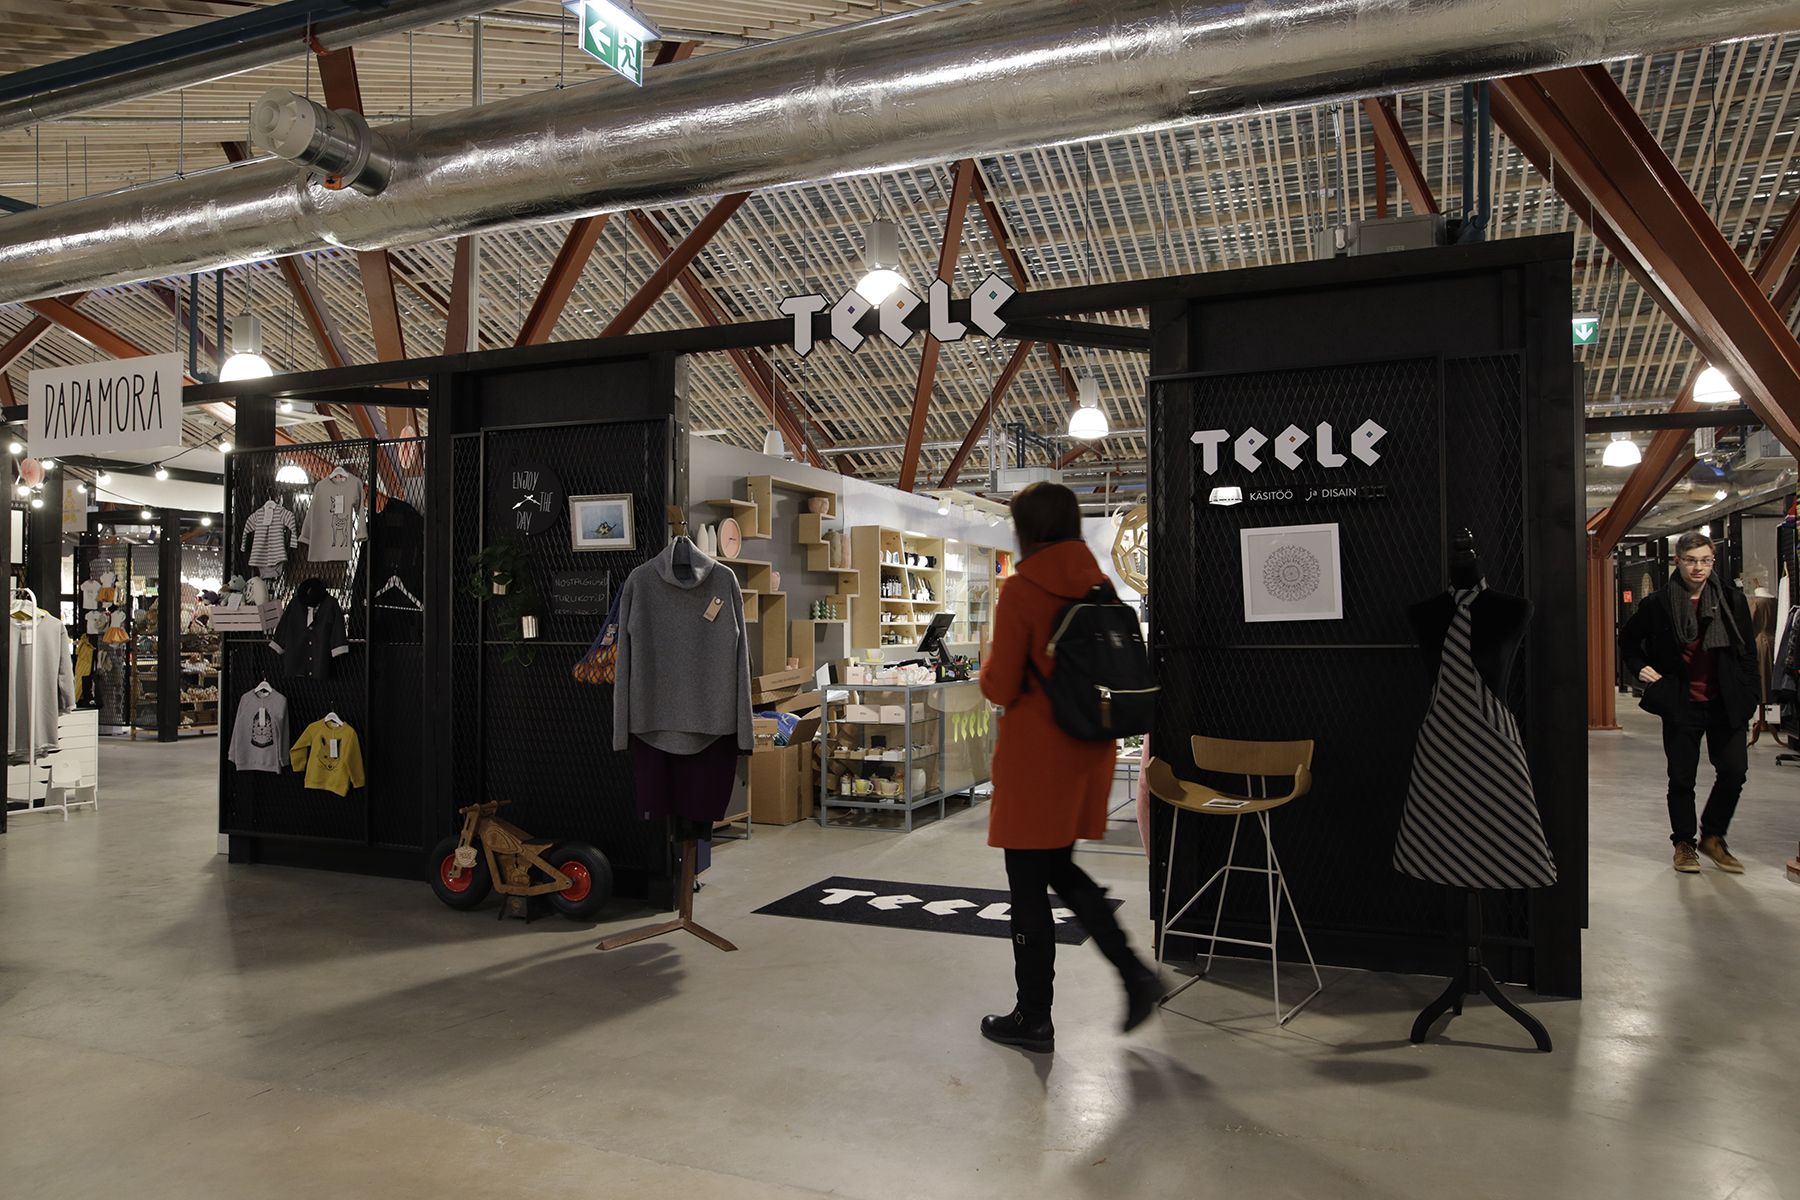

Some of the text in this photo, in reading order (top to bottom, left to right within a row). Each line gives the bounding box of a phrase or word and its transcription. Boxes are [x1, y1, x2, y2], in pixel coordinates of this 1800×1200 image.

[44, 370, 163, 440] DADAMORA
[512, 471, 540, 491] ENJOY
[539, 491, 554, 513] THE
[1249, 487, 1357, 502] KÄSITÖÖ ja DISAIN
[516, 510, 533, 532] DAY
